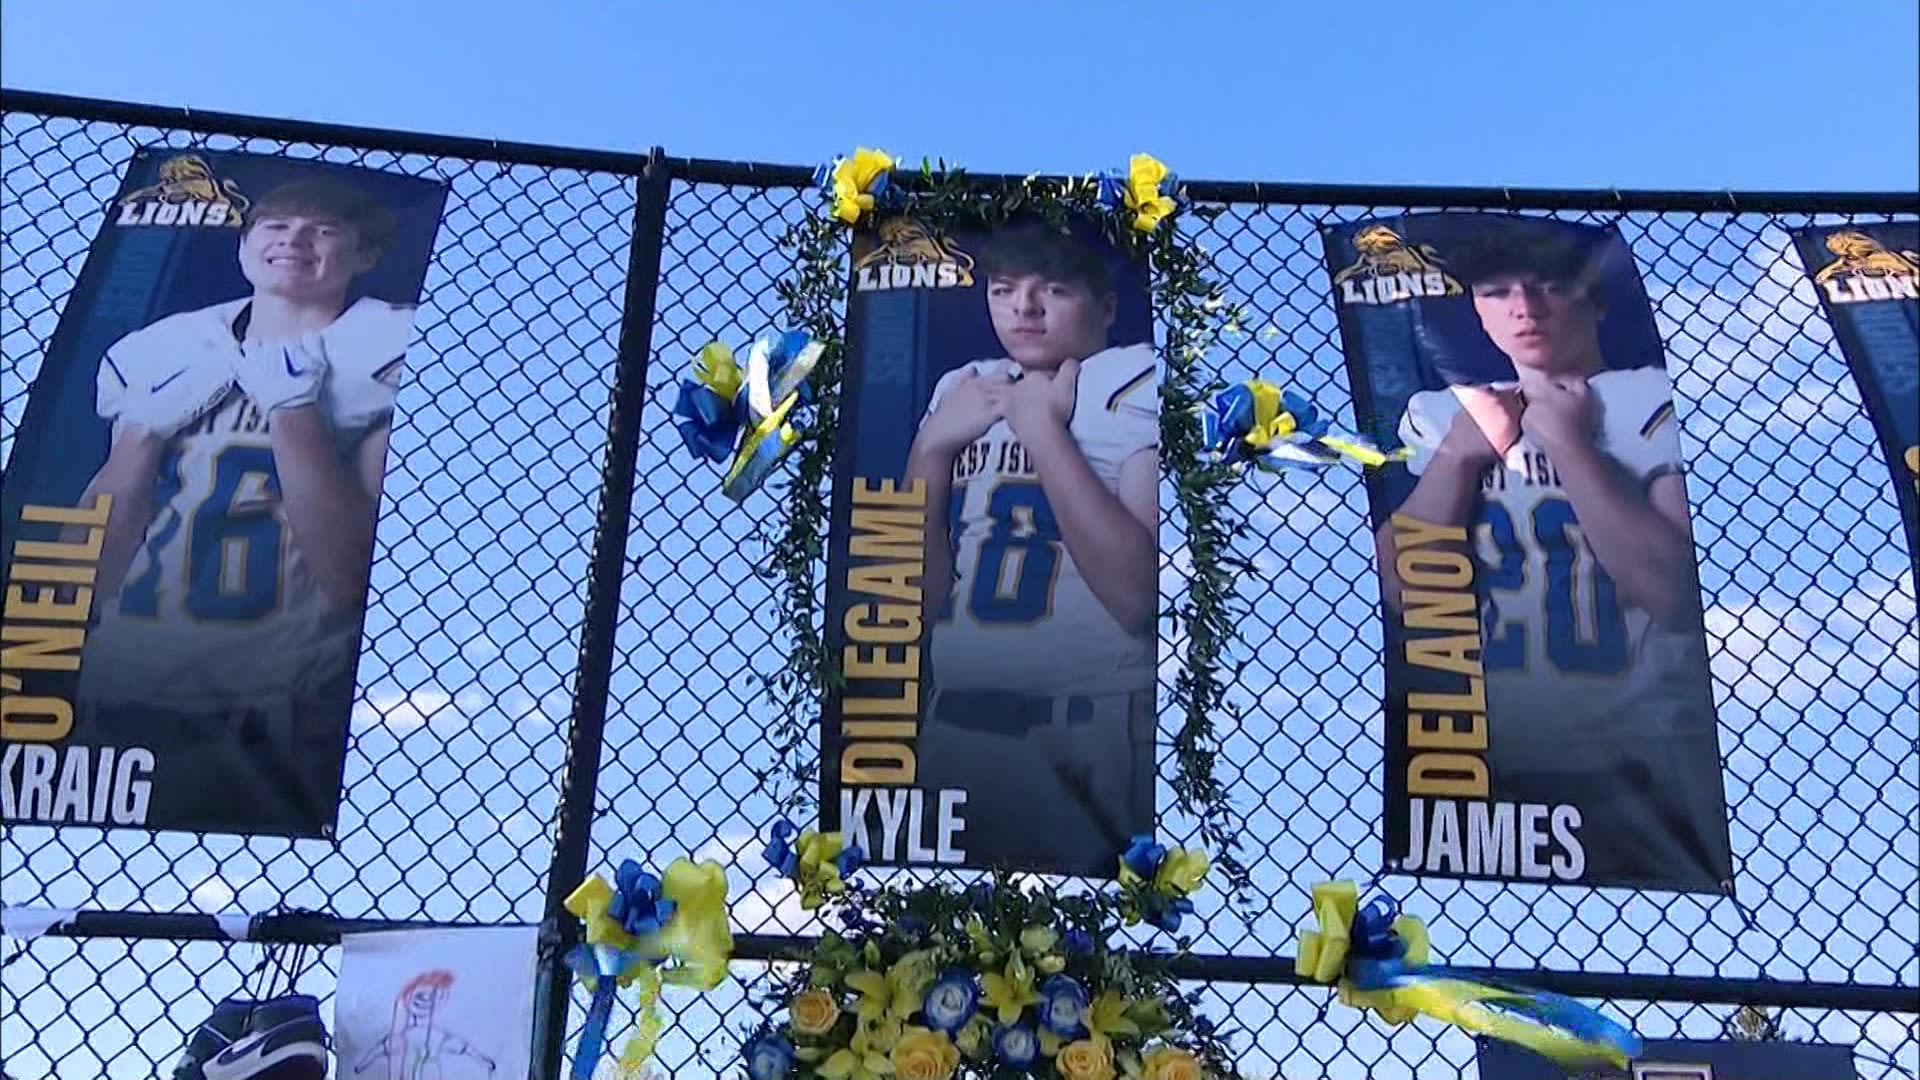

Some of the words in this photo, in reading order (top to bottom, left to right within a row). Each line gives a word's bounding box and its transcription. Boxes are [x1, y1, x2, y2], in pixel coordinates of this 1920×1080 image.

[116, 201, 230, 227] LIONS
[856, 263, 958, 291] LIONS
[1341, 270, 1446, 304] LIONS
[840, 476, 928, 784] DILEGAME
[1392, 514, 1489, 798] DELANOY
[840, 787, 967, 864] KYLE
[1404, 798, 1585, 880] JAMES
